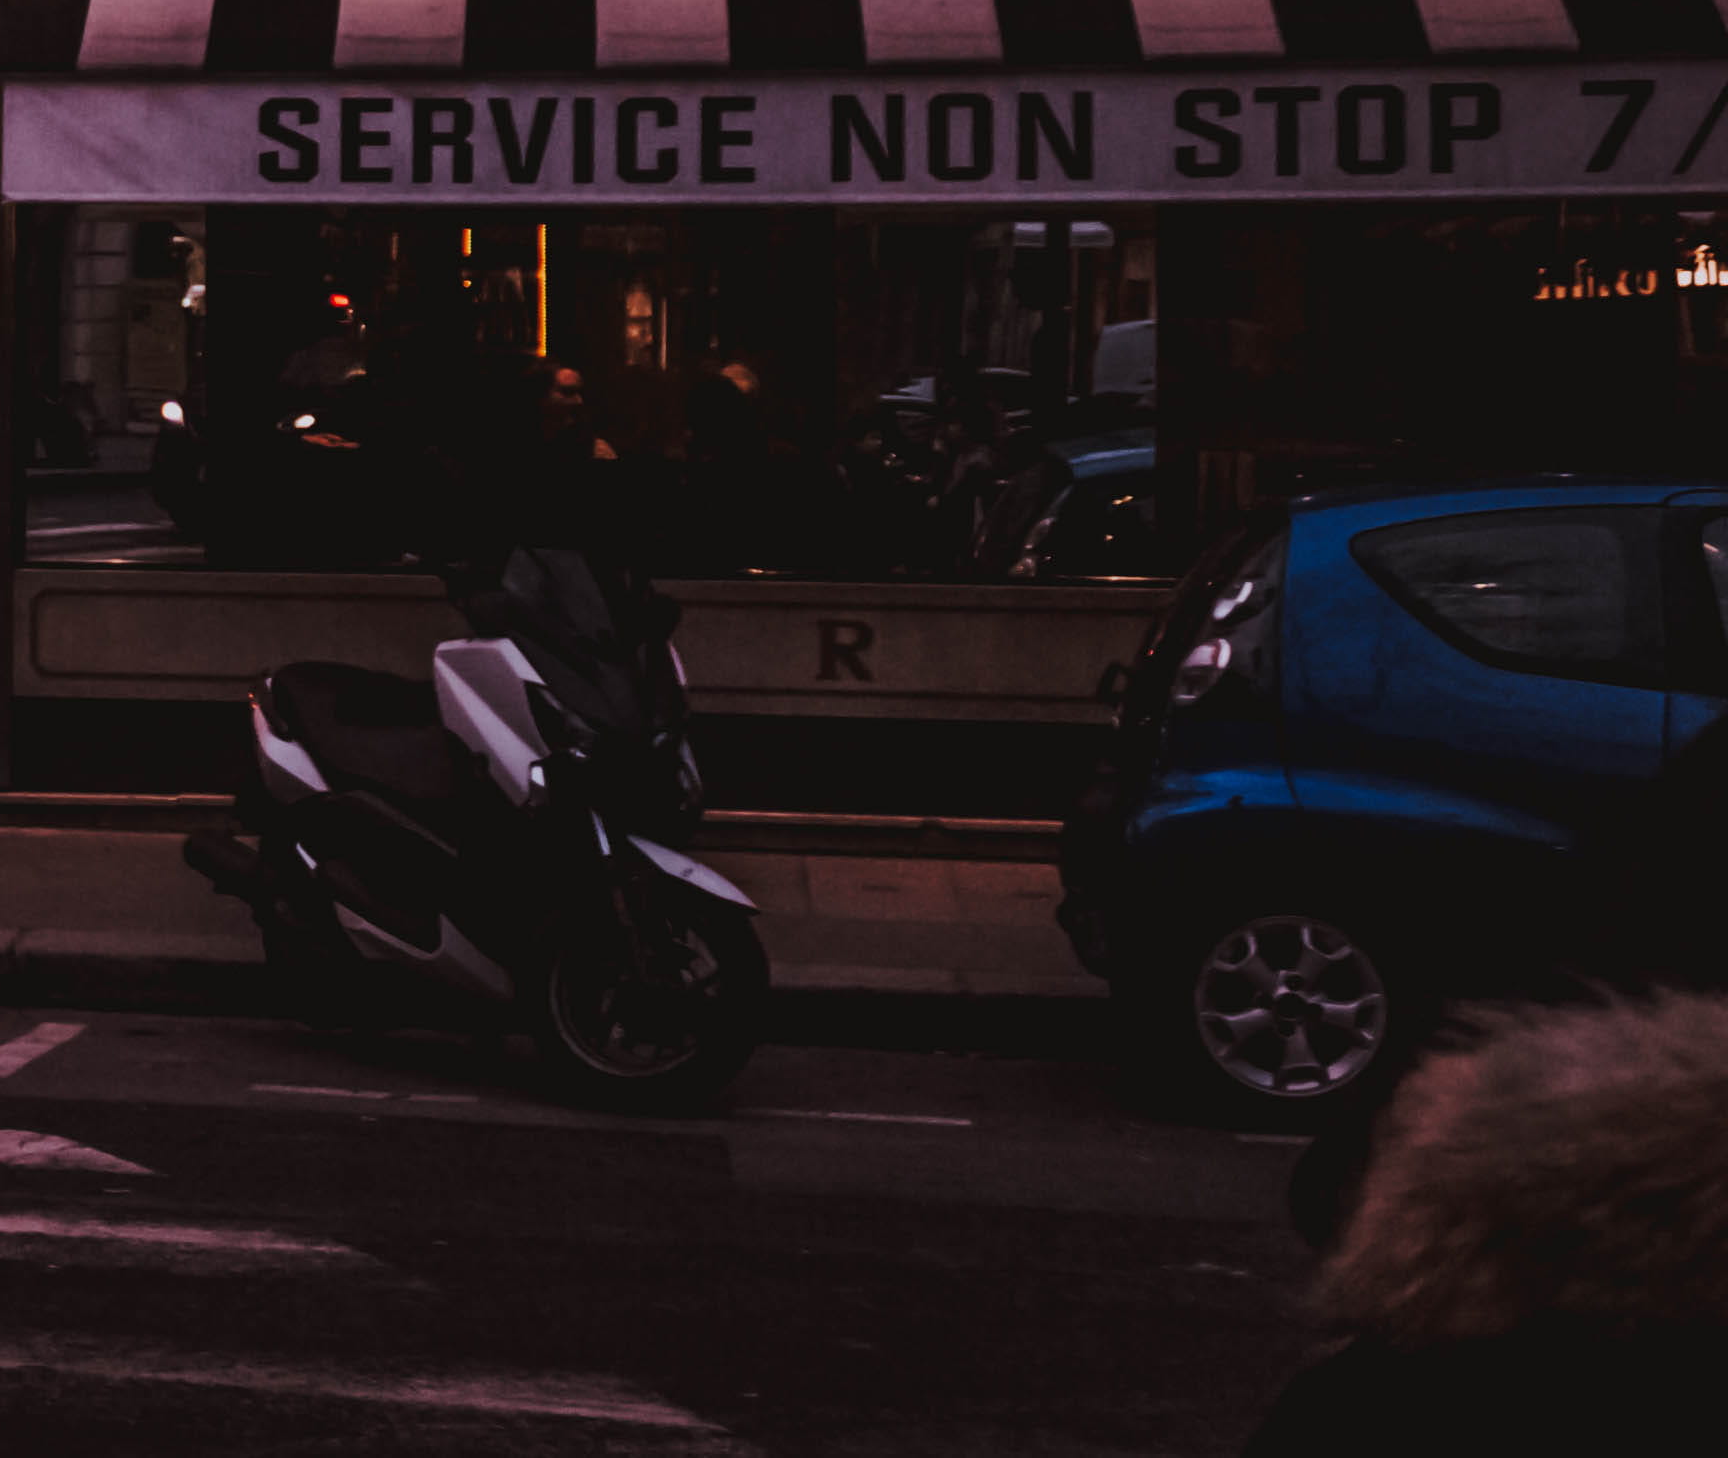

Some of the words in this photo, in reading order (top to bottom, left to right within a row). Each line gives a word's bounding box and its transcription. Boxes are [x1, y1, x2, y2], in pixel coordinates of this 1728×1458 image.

[257, 95, 757, 184] SERVICE
[830, 90, 1094, 182] NON
[1174, 83, 1500, 178] STOP
[816, 618, 875, 682] R
